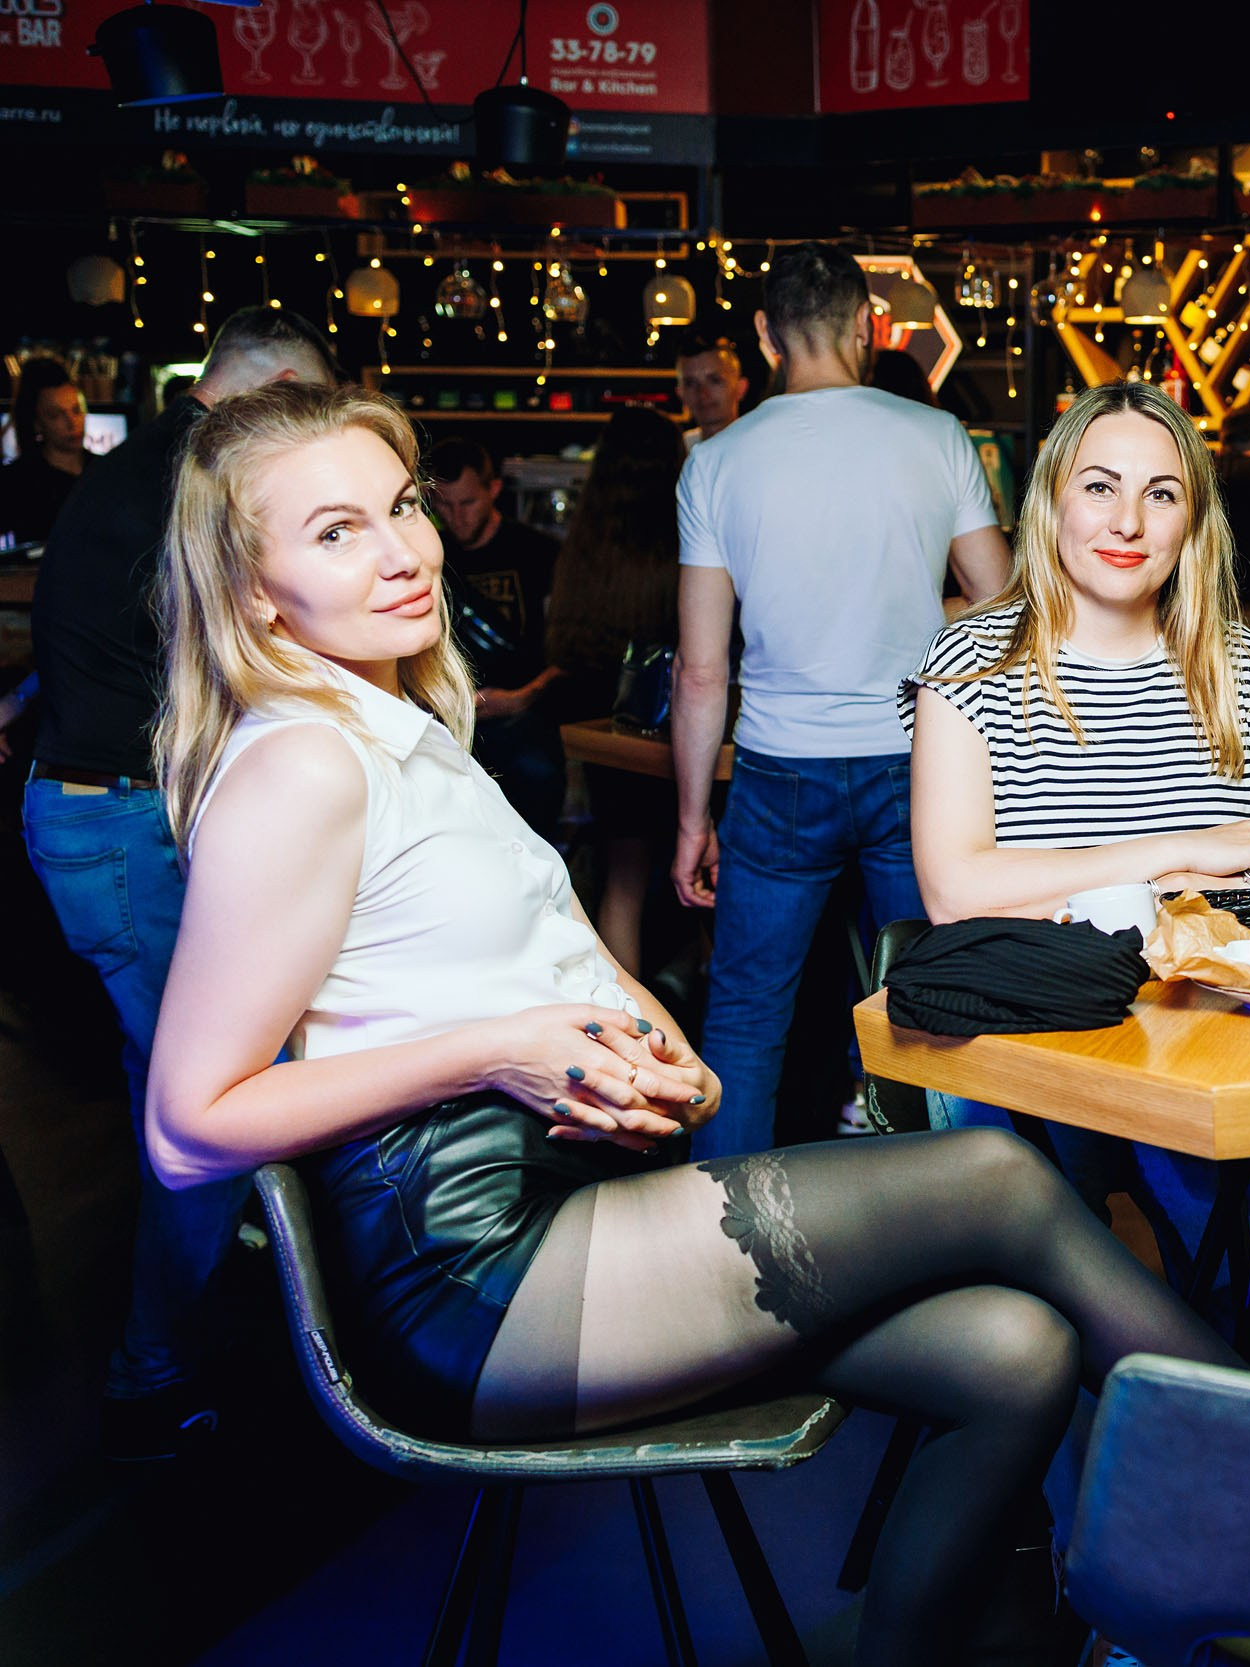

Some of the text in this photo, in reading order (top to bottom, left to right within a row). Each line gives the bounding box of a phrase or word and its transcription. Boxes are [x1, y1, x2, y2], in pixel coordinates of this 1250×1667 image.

[17, 18, 62, 47] BAR
[551, 37, 657, 65] 33-78-79
[551, 76, 658, 96] Bar & Kitchen
[153, 107, 181, 133] Не
